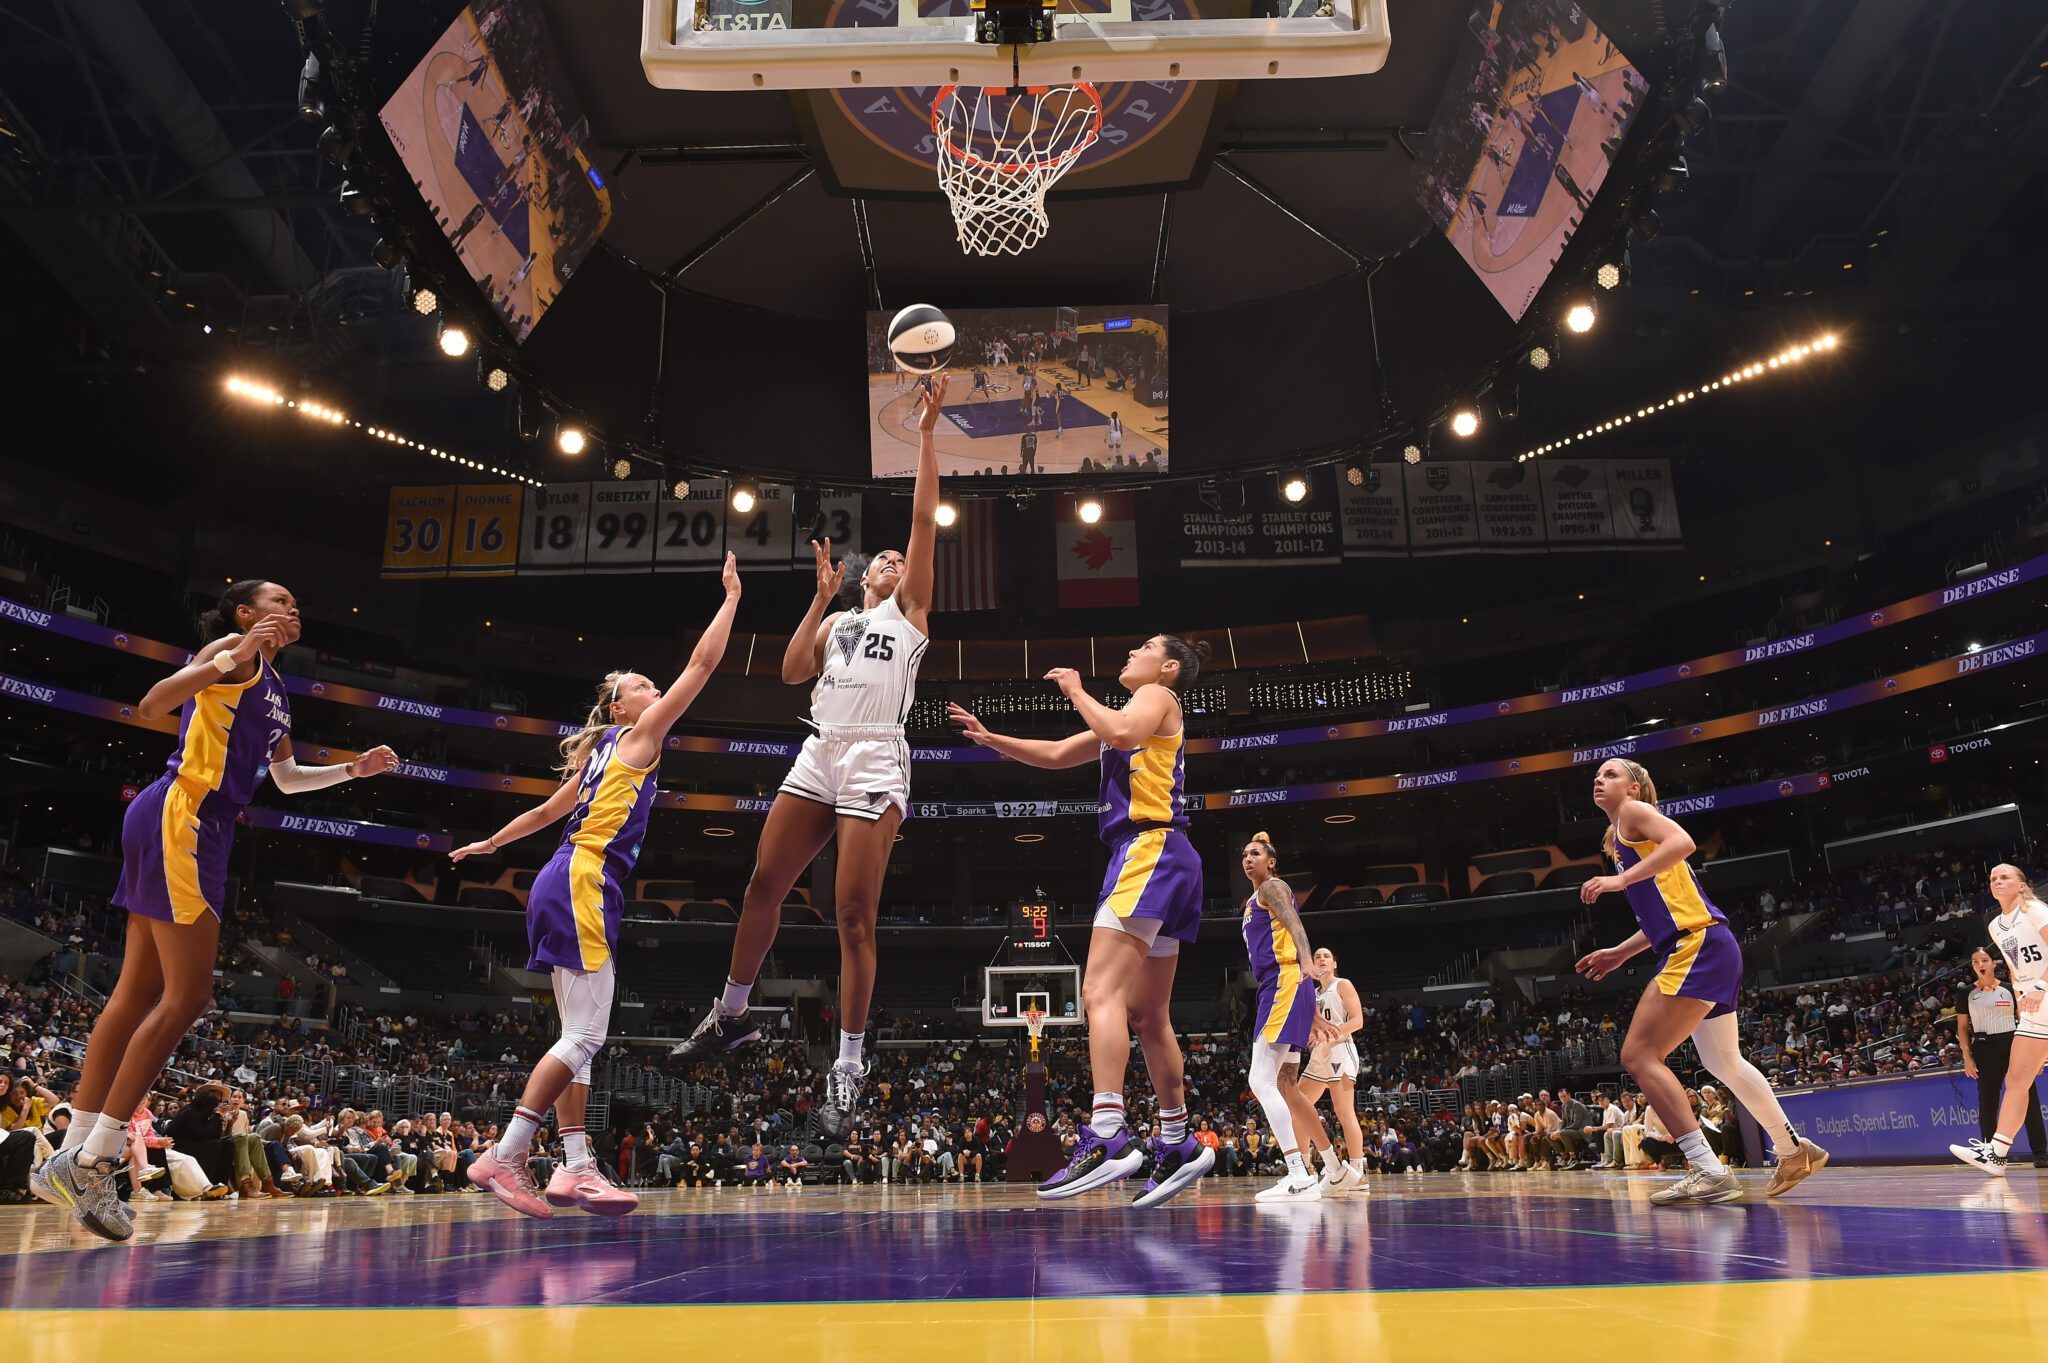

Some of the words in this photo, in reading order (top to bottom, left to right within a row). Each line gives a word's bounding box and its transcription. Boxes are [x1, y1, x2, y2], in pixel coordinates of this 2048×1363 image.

[1616, 469, 1662, 480] MILLER
[399, 495, 446, 507] VACHON
[465, 494, 512, 505] DIONNE
[596, 491, 651, 502] GRETZKY
[1350, 497, 1392, 506] WESTERN
[1418, 494, 1462, 504] WESTERN
[1484, 494, 1531, 502] CAMPBELL
[1558, 492, 1593, 500] SMYTHE
[1344, 506, 1400, 516] CONFERENCE
[1412, 504, 1471, 515] CONFERENCE
[1480, 503, 1538, 513] CONFERENCE
[1557, 502, 1597, 511] DIVISION
[1262, 512, 1309, 523] STANLEY
[1310, 512, 1332, 522] CUP
[1348, 516, 1398, 526] CHAMPIONS
[1416, 513, 1469, 525] CHAMPIONS
[1484, 512, 1536, 522] CHAMPIONS
[1552, 511, 1605, 521] CHAMPIONS
[534, 515, 573, 550] 18
[596, 512, 647, 549] 99
[664, 511, 716, 547] 20
[745, 510, 771, 546] 4
[1184, 524, 1254, 535] CHAMPIONS
[1262, 523, 1333, 535] CHAMPIONS
[1356, 529, 1393, 539] 2013-14
[1425, 527, 1464, 538] 2011-12
[1491, 526, 1533, 536] 1992-93
[1560, 523, 1600, 534] 1990-91
[392, 517, 442, 553] 30
[464, 516, 505, 553] 16
[1194, 541, 1247, 554] 2013-14
[1274, 540, 1325, 553] 2011-12
[864, 633, 895, 661] 25
[264, 686, 282, 708] LOS
[265, 704, 291, 729] ANGE
[1949, 738, 1991, 754] TOYOTA
[1832, 767, 1871, 781] TOYOTA
[920, 805, 938, 817] 65
[956, 806, 986, 816] Sparks
[1001, 803, 1037, 817] 9:22
[1047, 807, 1054, 816] 4
[1059, 804, 1099, 813] VALKYRIE
[1022, 906, 1048, 918] 9:22
[1033, 918, 1046, 938] 9
[2020, 944, 2042, 963] 35
[1816, 1116, 1853, 1138] Budget.
[1854, 1114, 1890, 1136] Spend.
[1891, 1110, 1919, 1130] Earn.
[1949, 1104, 1980, 1126] Albe
